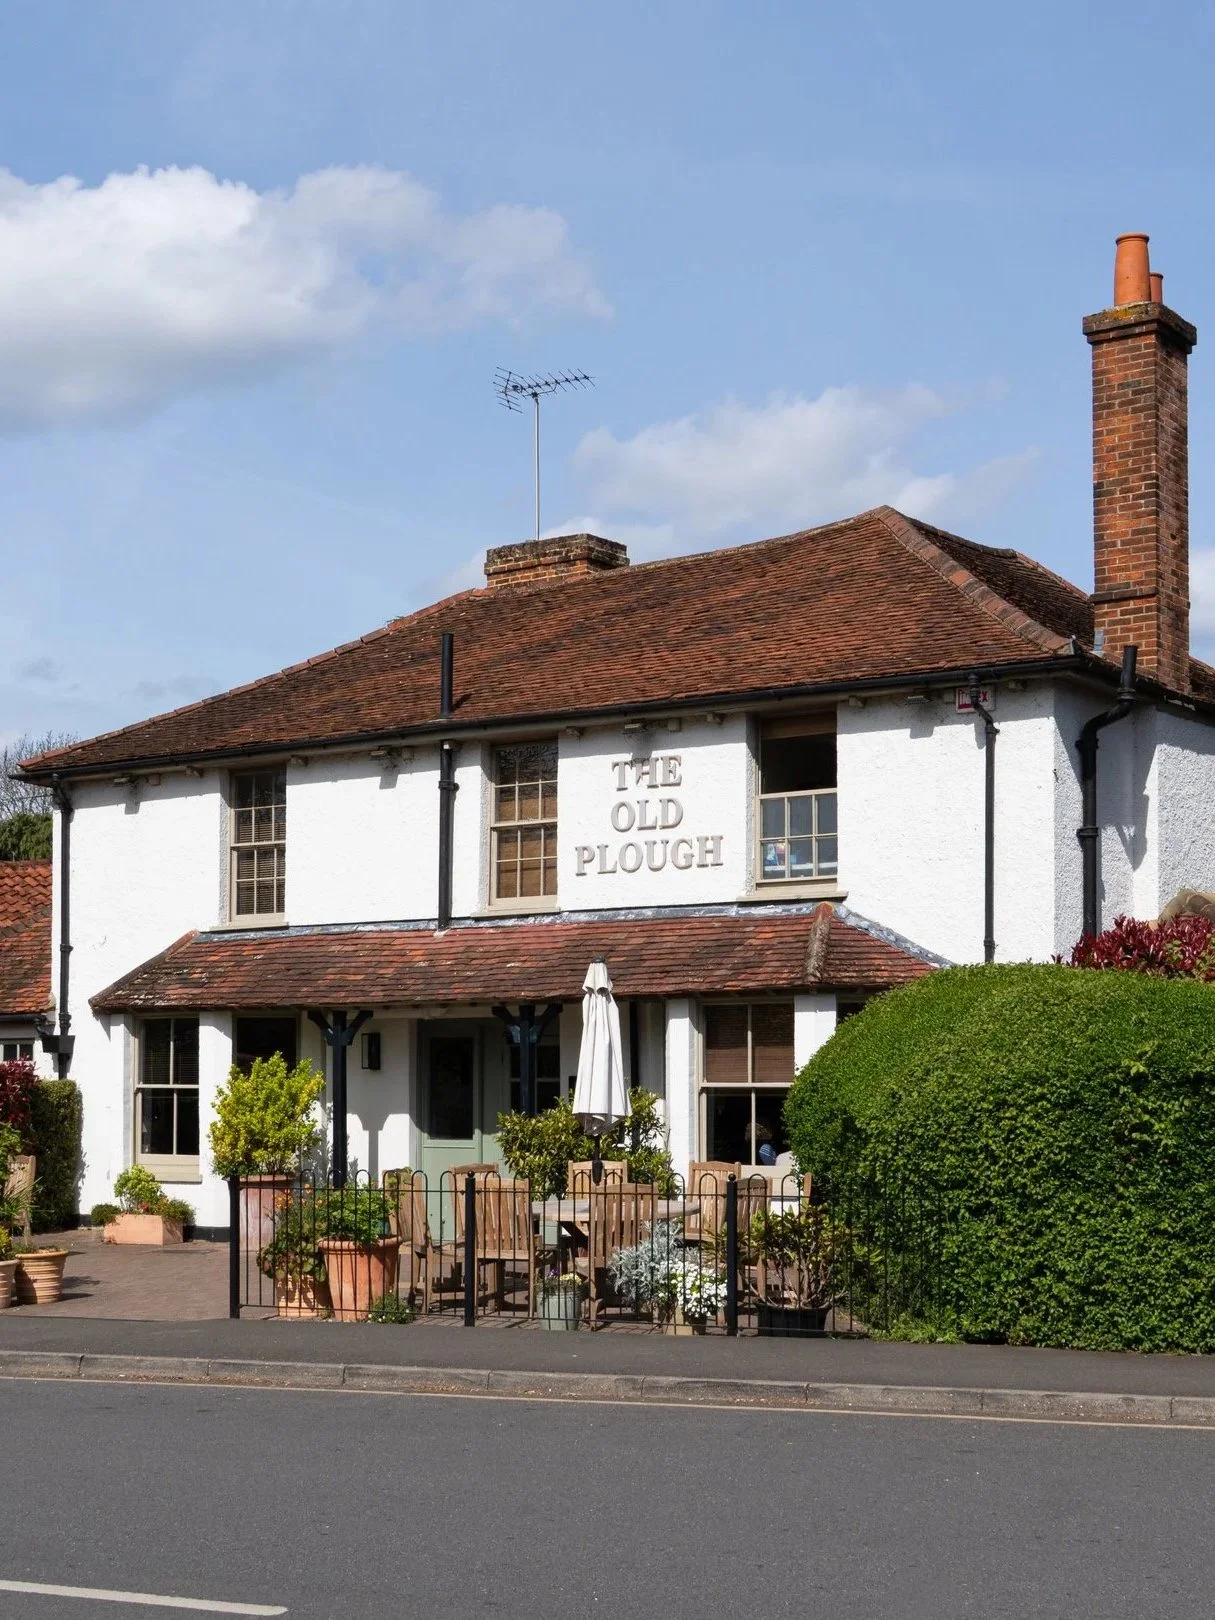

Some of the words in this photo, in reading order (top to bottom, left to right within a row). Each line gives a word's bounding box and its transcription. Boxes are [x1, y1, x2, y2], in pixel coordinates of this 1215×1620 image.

[611, 755, 682, 791] THE
[610, 798, 683, 832] OLD
[575, 835, 723, 876] PLOUGH
